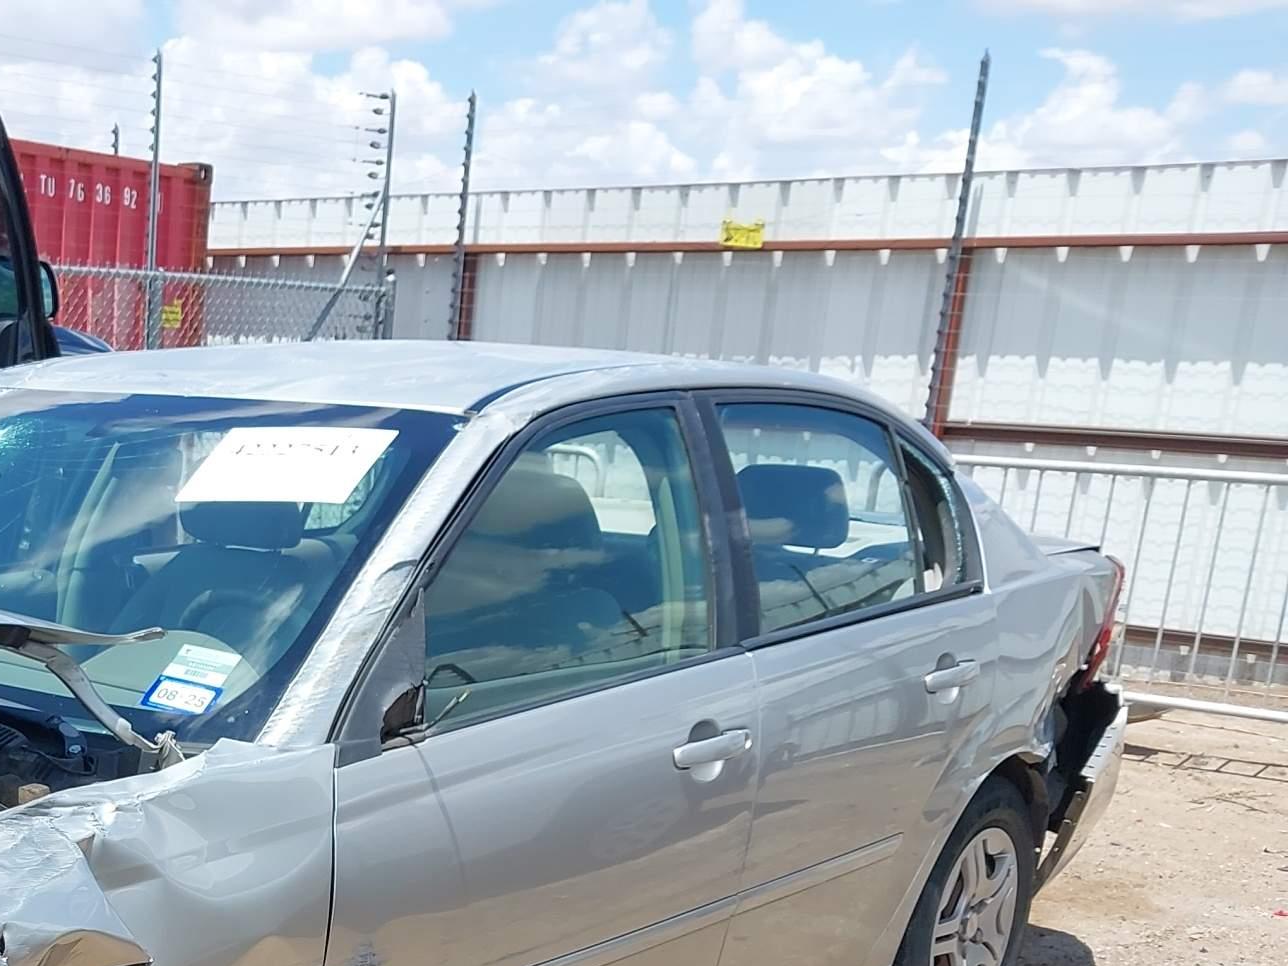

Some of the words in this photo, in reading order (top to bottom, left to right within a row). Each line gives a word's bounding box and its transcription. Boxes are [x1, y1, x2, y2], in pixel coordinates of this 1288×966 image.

[40, 174, 55, 197] TU
[68, 178, 85, 202] 76
[95, 183, 111, 205] 36
[123, 187, 137, 209] 92
[157, 687, 179, 701] 08
